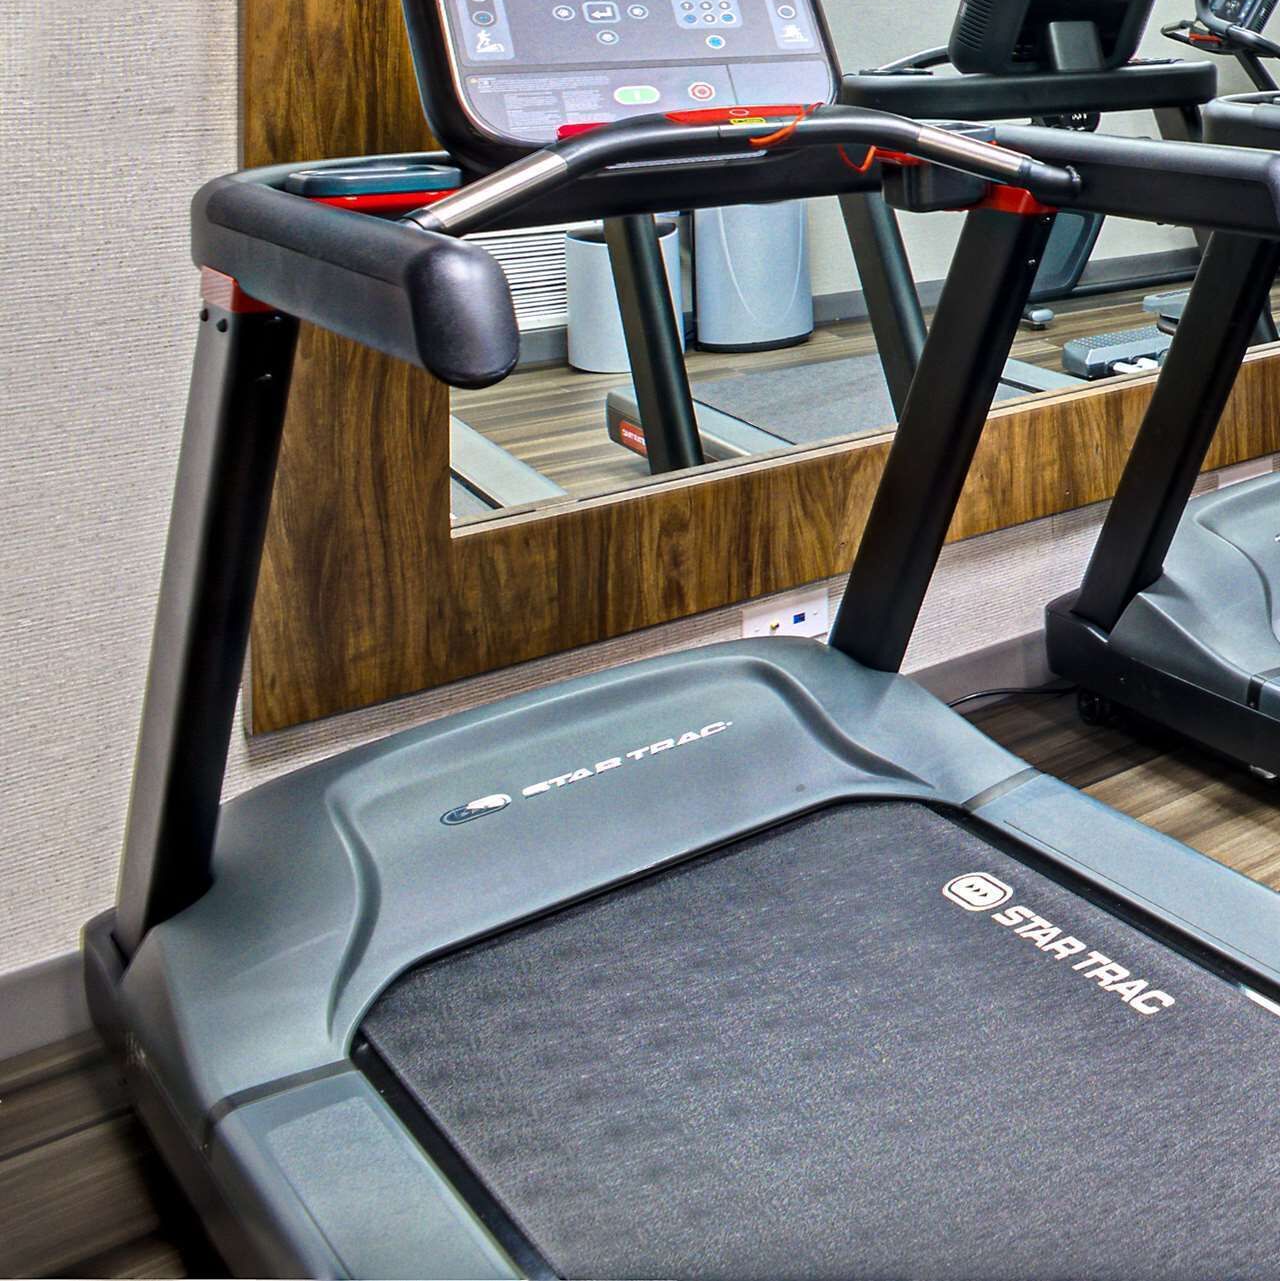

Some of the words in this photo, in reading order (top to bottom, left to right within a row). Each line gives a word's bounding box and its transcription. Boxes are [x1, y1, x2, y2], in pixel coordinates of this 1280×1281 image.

[522, 756, 623, 798] STAR
[626, 721, 728, 760] TRAC
[991, 904, 1087, 960] STAR
[1071, 950, 1176, 1015] TRAC
